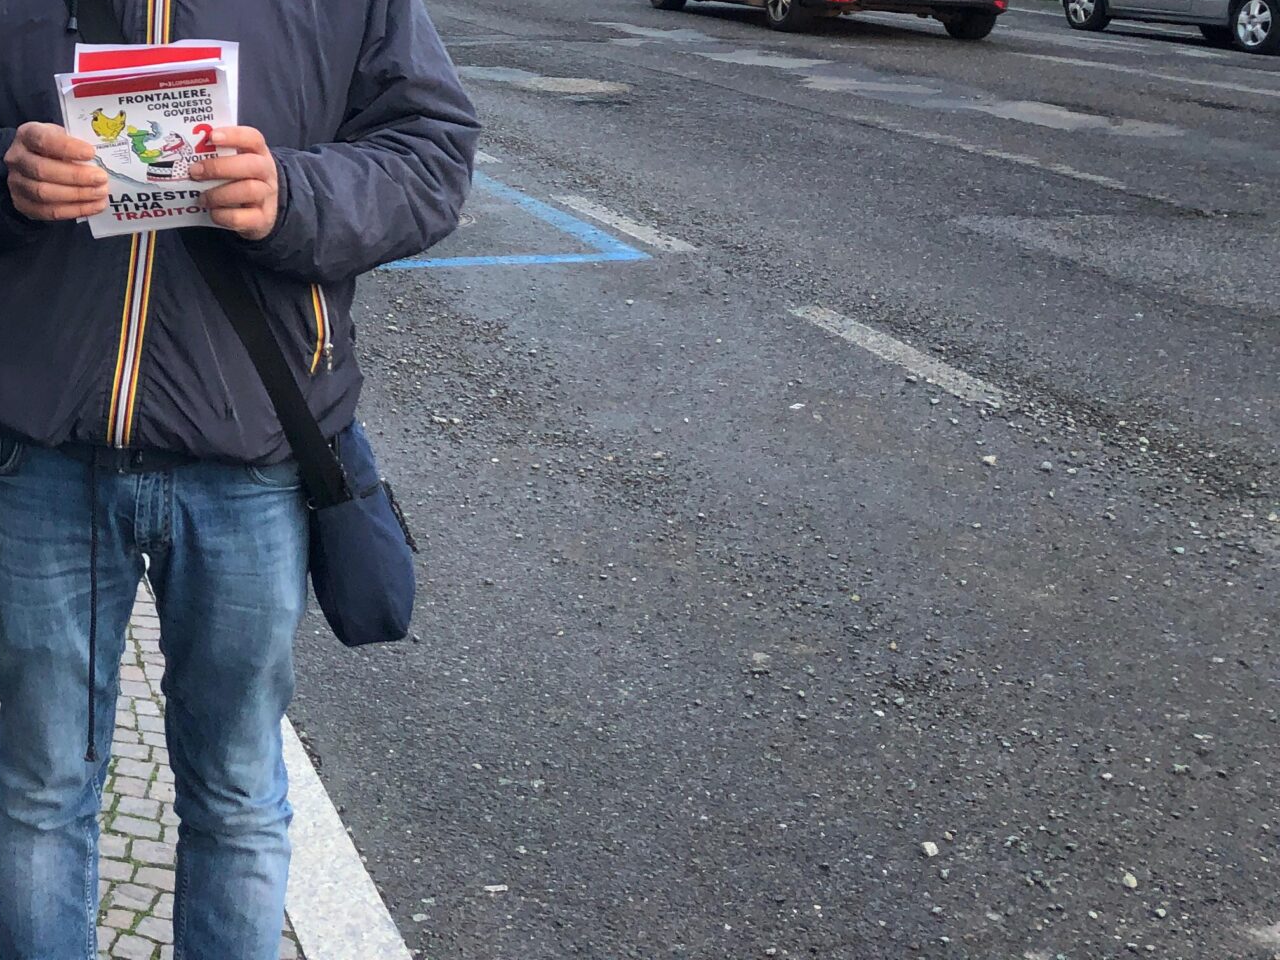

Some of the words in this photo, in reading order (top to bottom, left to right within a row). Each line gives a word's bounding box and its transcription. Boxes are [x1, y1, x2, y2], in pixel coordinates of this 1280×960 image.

[118, 88, 211, 105] FRONTALIERE,
[147, 102, 169, 111] CON
[171, 98, 212, 109] QUESTO
[163, 105, 213, 117] GOVERNO
[183, 114, 214, 124] PAGHI
[192, 123, 217, 154] 2
[108, 193, 133, 204] LA
[137, 190, 201, 202] DESTR
[109, 204, 129, 213] TI
[134, 201, 164, 211] HA
